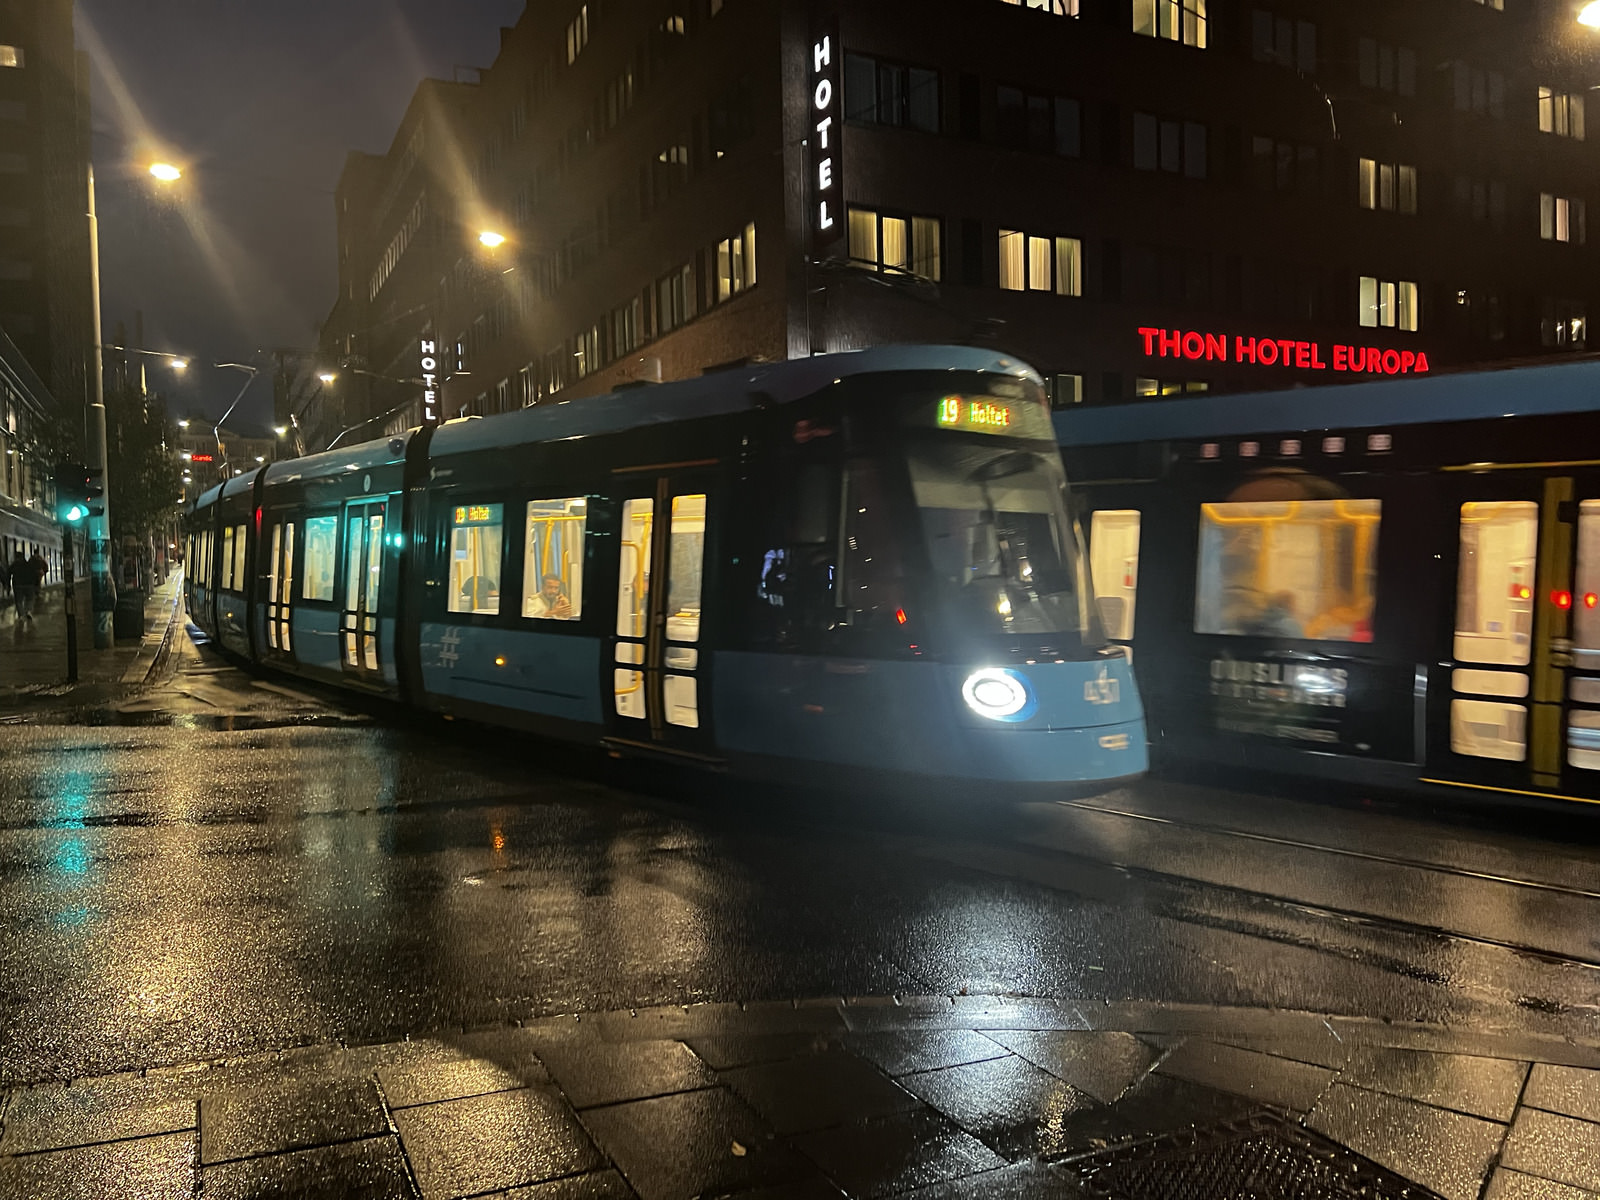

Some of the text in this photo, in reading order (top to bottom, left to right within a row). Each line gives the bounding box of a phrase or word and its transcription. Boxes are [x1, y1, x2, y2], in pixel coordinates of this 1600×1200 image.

[814, 35, 833, 230] HOTEL
[421, 340, 436, 420] HOTEL
[1138, 327, 1429, 375] THON HOTEL EUROPA
[939, 398, 1009, 426] 19 Holtet
